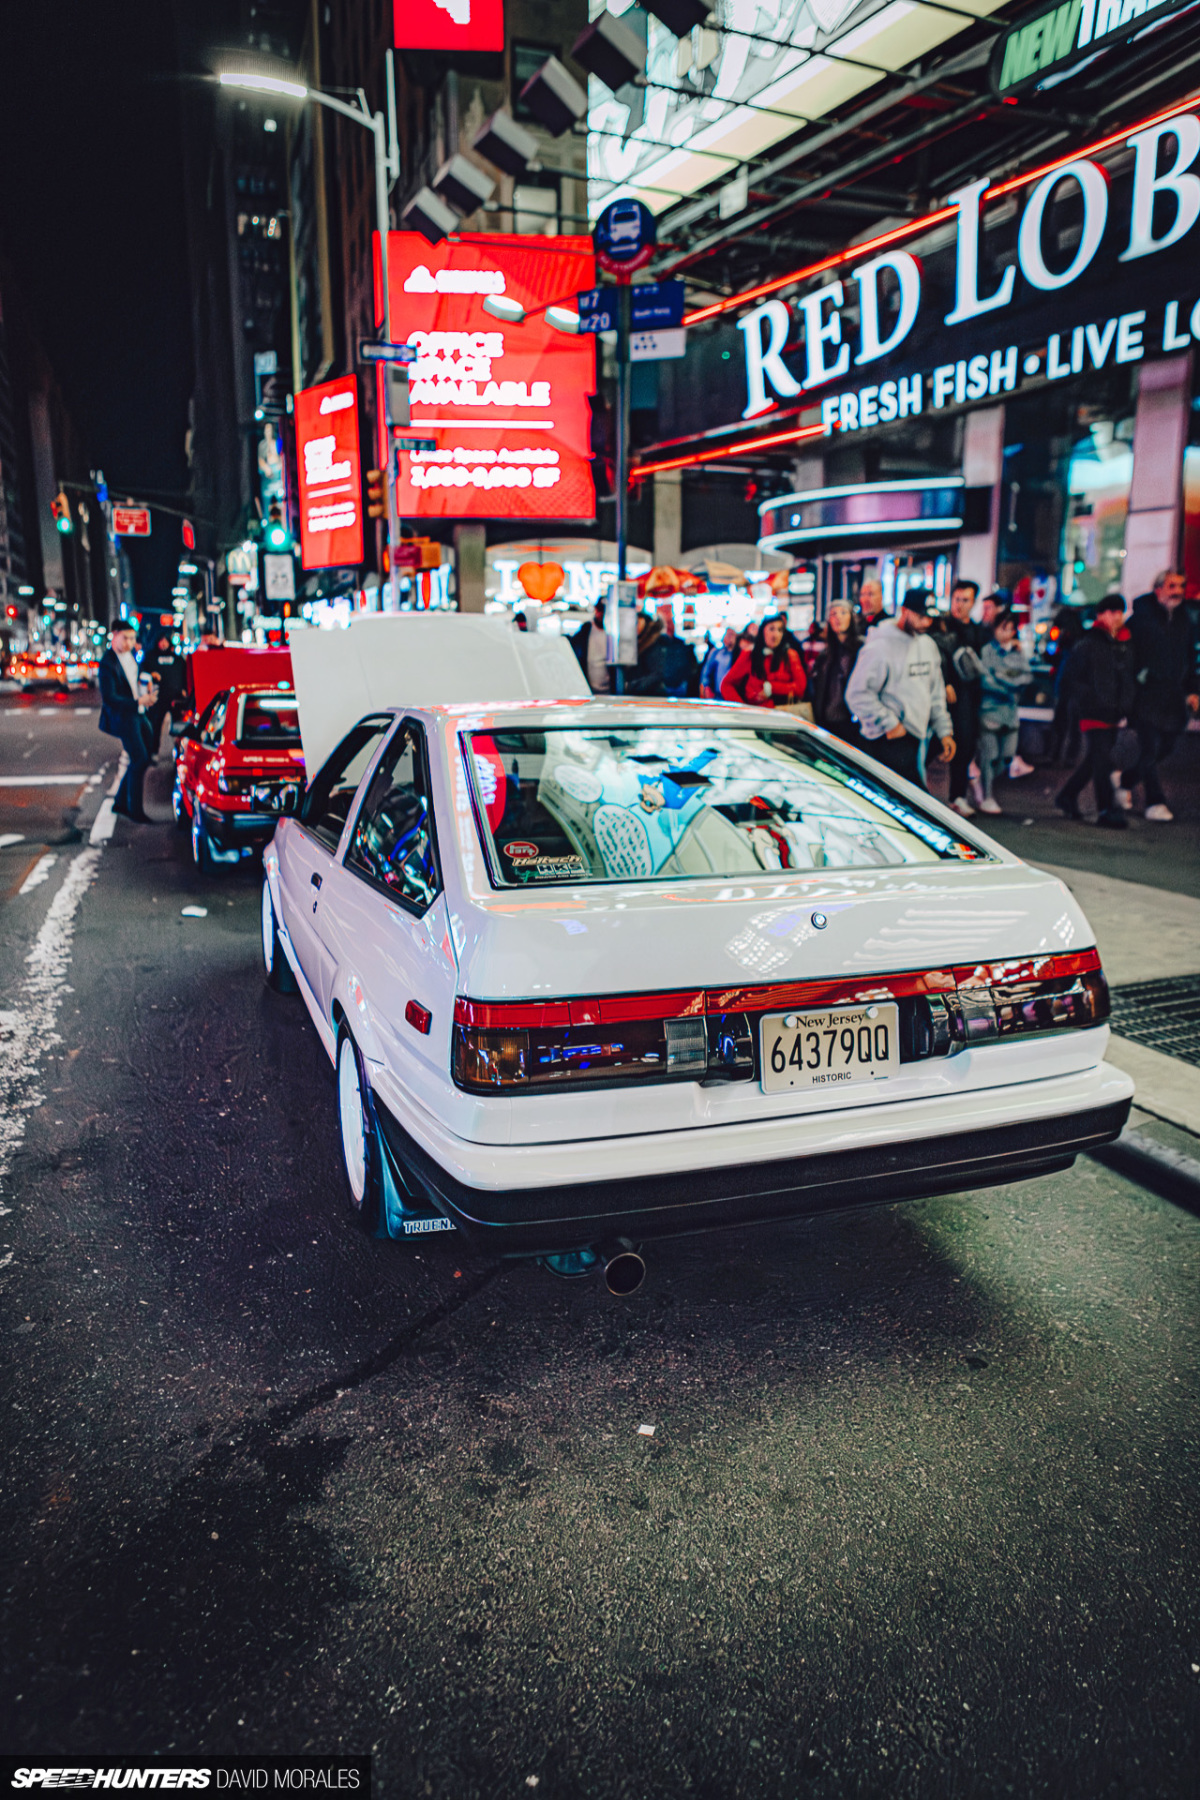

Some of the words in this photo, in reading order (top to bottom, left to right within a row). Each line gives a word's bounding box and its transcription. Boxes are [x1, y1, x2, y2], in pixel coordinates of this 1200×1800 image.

[999, 0, 1082, 90] NEW
[736, 250, 923, 420] RED
[822, 373, 922, 436] FRESH
[933, 346, 1018, 409] FISH
[1047, 310, 1146, 380] LIVE
[796, 1016, 826, 1029] New
[827, 1013, 865, 1029] Jersey
[771, 1024, 889, 1073] 64379QQ
[812, 1072, 852, 1084] HISTORIC
[403, 1218, 457, 1234] TRUEN
